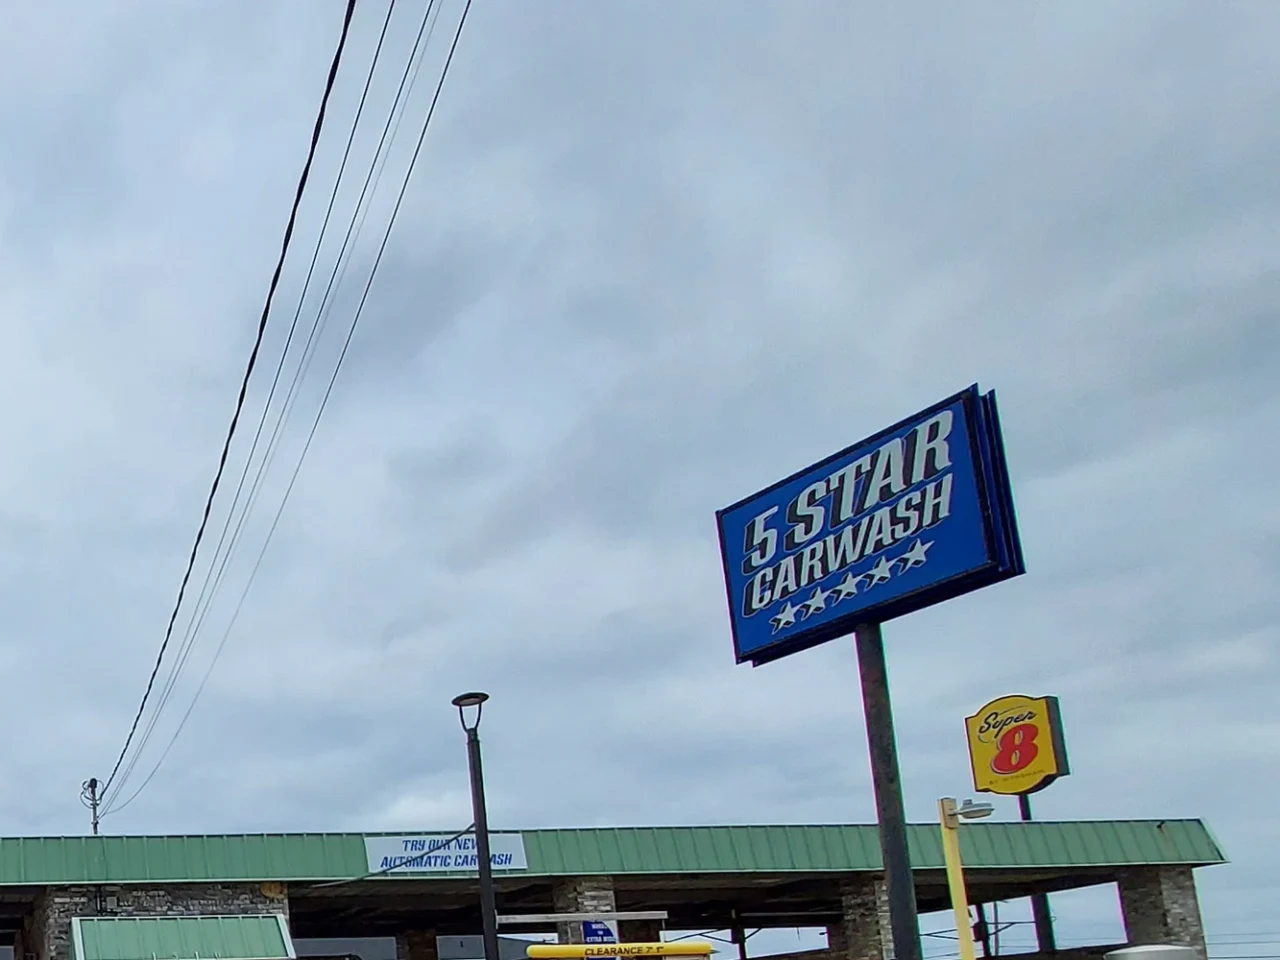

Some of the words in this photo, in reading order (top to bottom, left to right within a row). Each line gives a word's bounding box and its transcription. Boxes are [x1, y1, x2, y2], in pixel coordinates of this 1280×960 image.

[742, 506, 779, 575] 5
[784, 410, 954, 552] STAR
[743, 474, 953, 617] CARWASH
[979, 711, 1037, 739] Super
[990, 723, 1039, 774] 8
[402, 839, 425, 852] TRY
[428, 838, 451, 851] OUR
[380, 854, 451, 868] AUTOMATIC
[453, 853, 513, 867] CARASH
[584, 947, 643, 956] CLEARANCE
